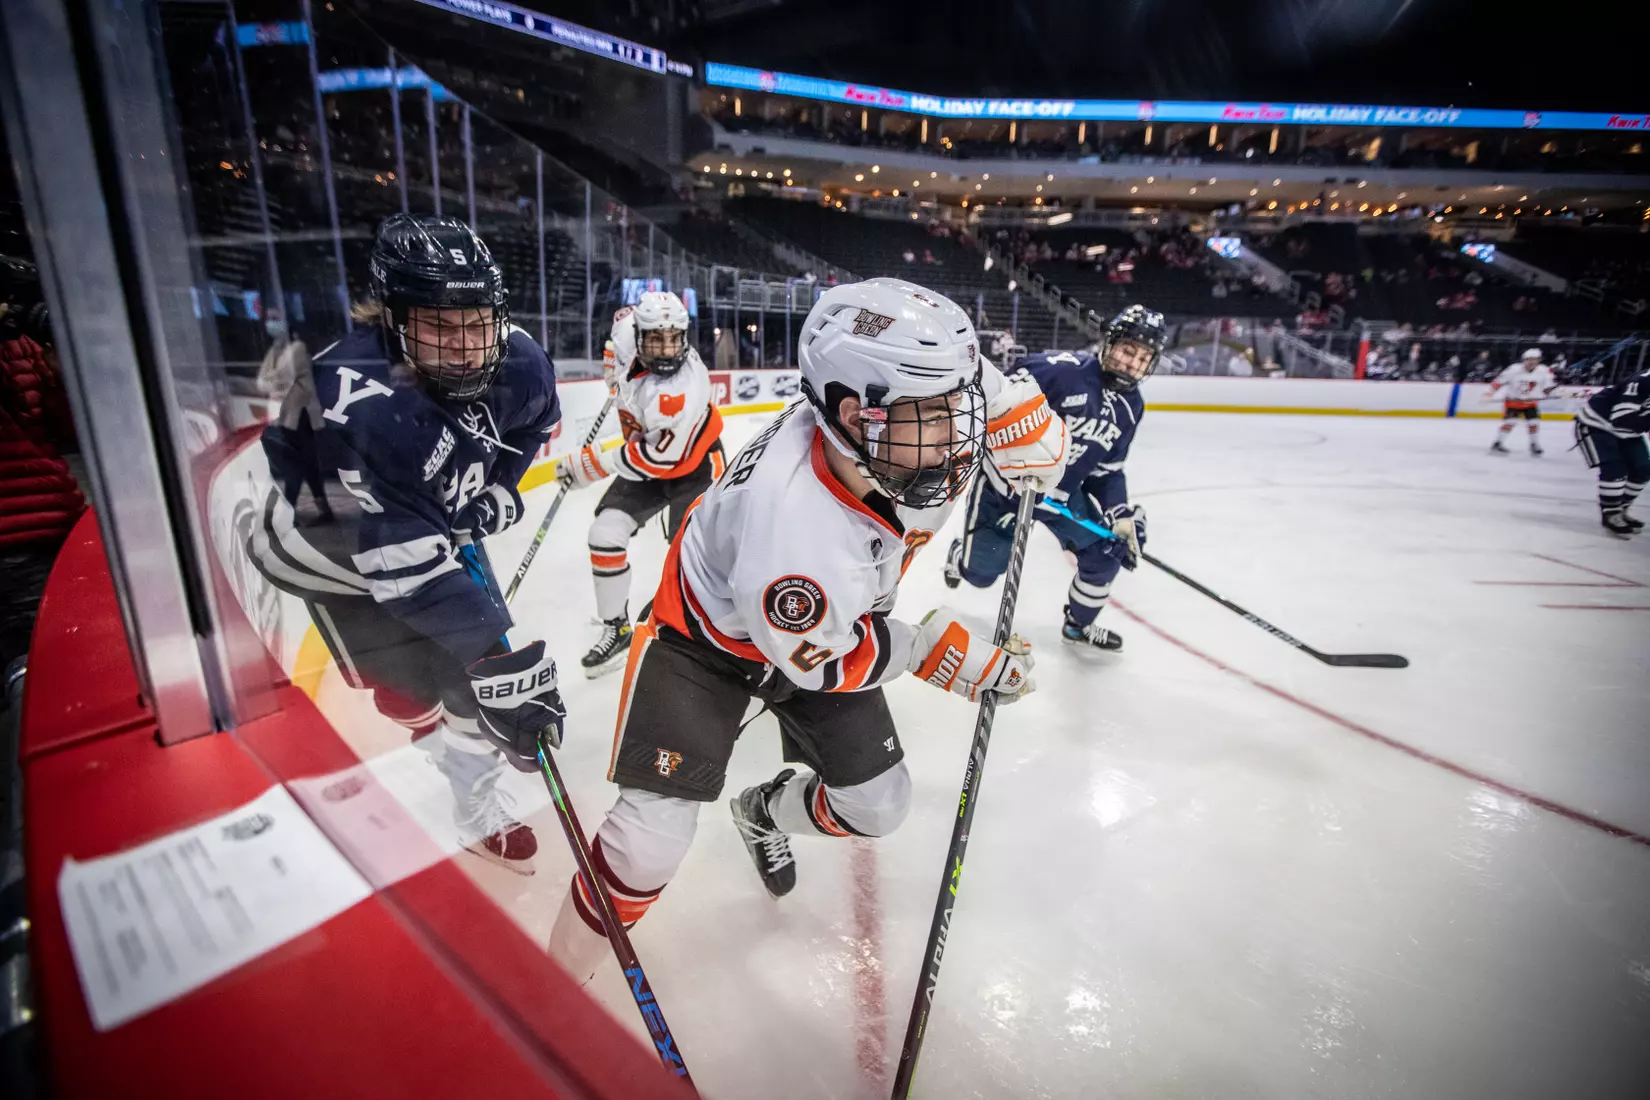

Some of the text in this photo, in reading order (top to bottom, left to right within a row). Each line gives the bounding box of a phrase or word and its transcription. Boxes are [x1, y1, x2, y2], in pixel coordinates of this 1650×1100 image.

[911, 95, 985, 116] HOLIDAY
[1293, 105, 1374, 123] HOLIDAY
[449, 248, 468, 266] 5
[446, 281, 485, 289] BAUER
[854, 309, 896, 329] BOWLING
[853, 321, 882, 338] GREEN
[322, 366, 395, 425] Y
[1622, 382, 1640, 397] 11
[774, 579, 822, 600] BOWLING GREEN
[768, 611, 790, 629] HOCKEY
[788, 639, 835, 673] 6
[479, 660, 558, 699] BAUER
[963, 757, 975, 791] ALPHA
[959, 791, 968, 808] LX
